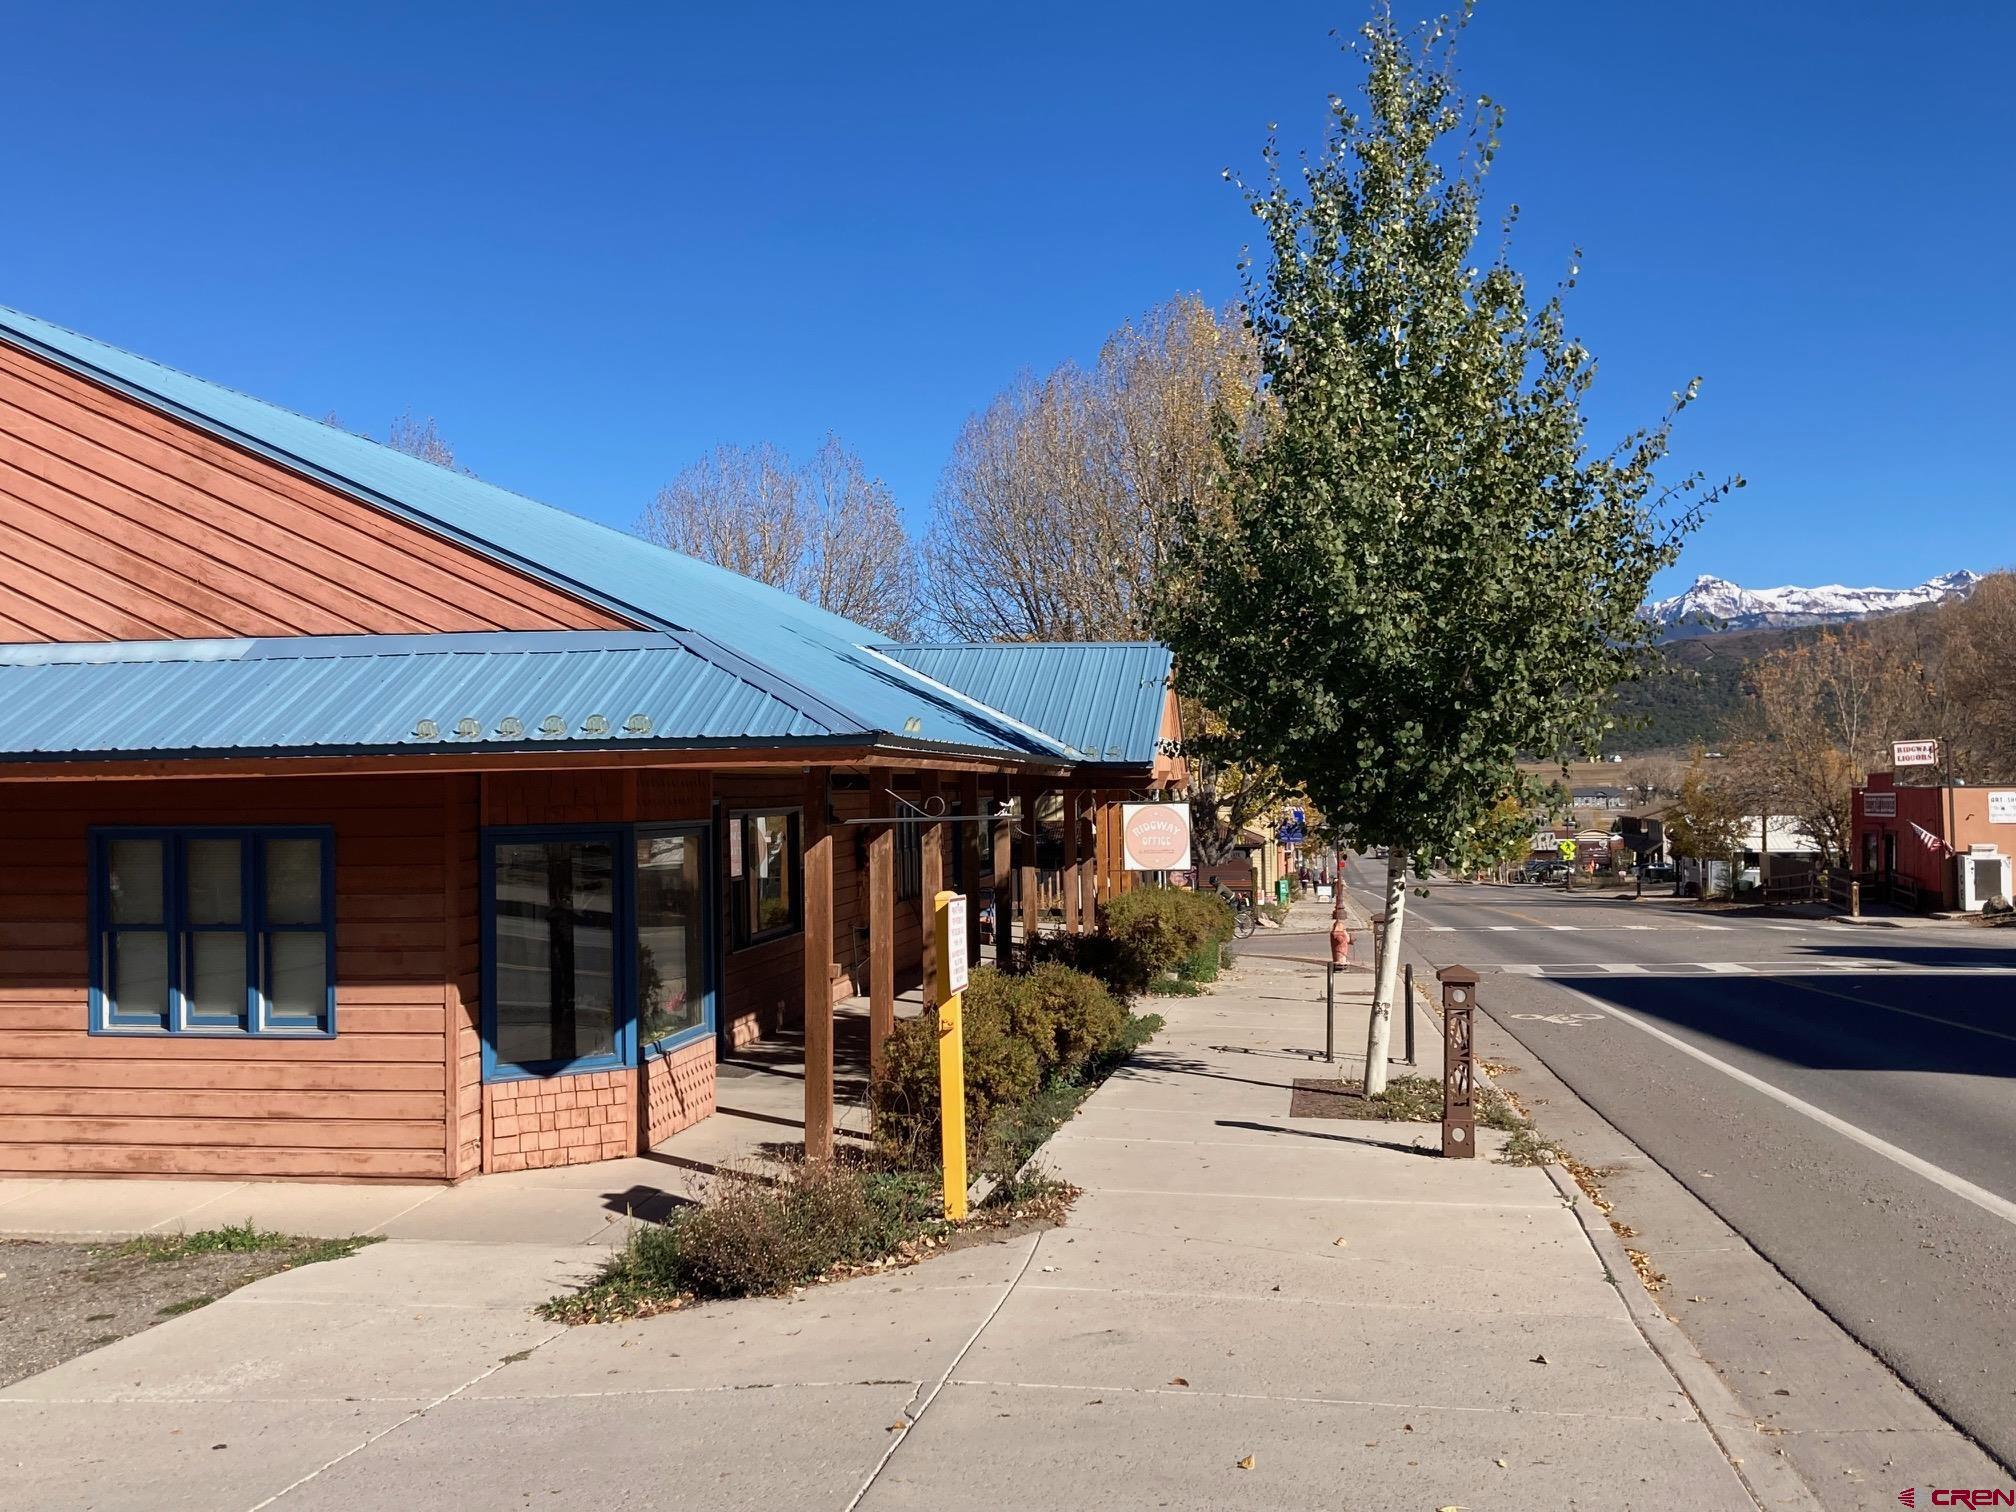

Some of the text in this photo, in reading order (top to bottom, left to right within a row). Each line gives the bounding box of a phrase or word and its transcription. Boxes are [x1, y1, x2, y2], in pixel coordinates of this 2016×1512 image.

[1897, 754, 1932, 762] LIQUORS
[1132, 820, 1181, 838] RIDGWAY
[1142, 836, 1171, 846] OFFICE
